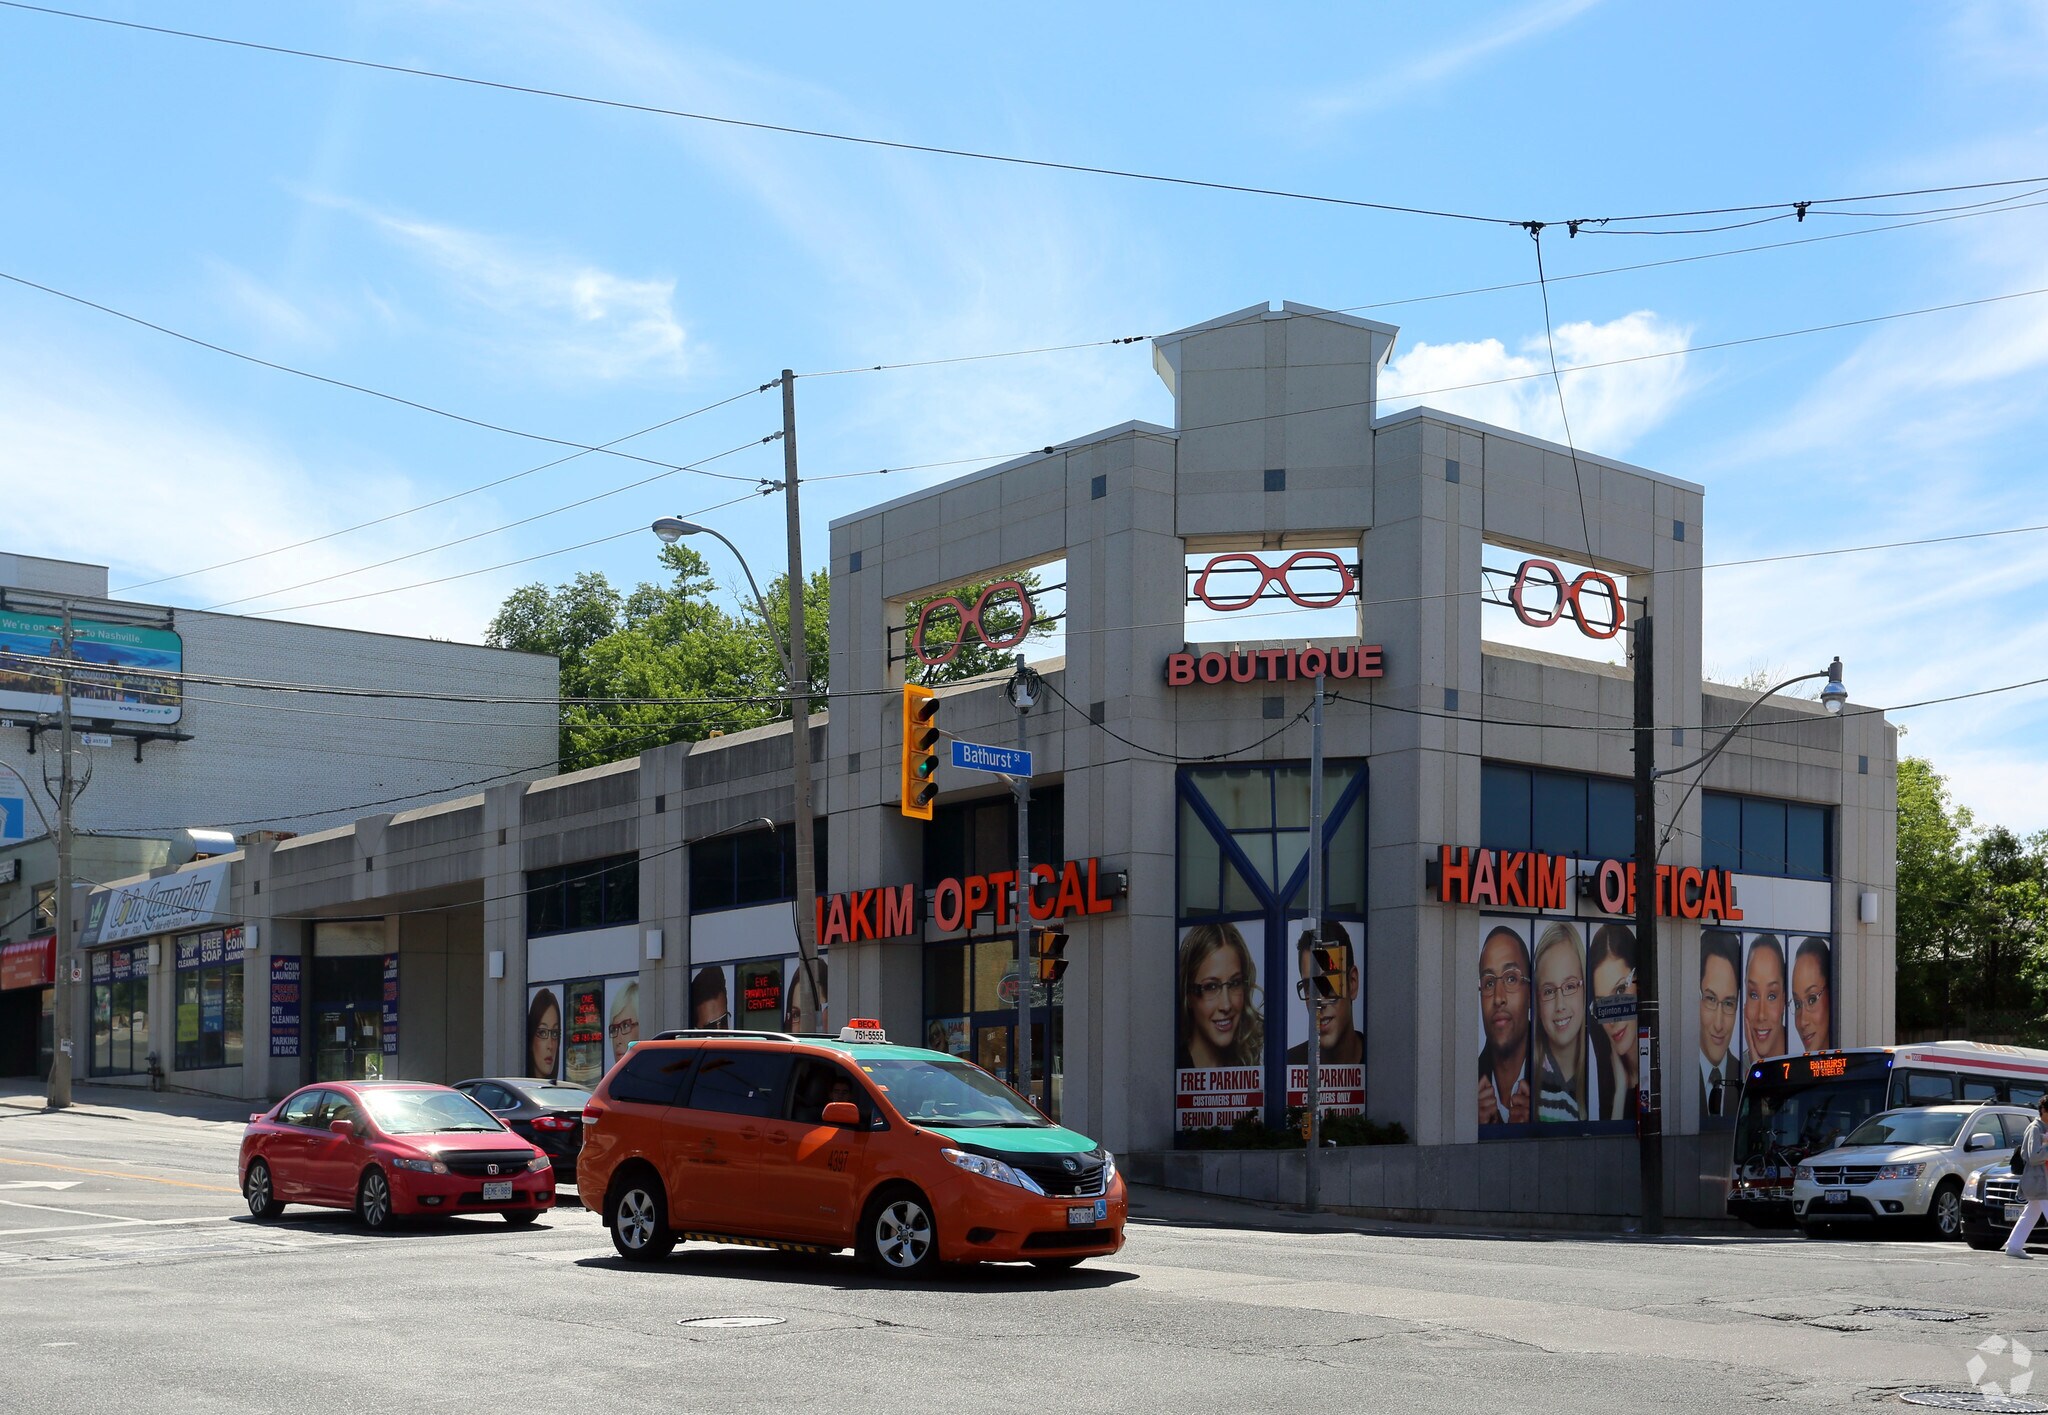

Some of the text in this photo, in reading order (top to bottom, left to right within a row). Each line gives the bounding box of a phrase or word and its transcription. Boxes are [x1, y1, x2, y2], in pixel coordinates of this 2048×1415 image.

[2, 618, 30, 631] We're
[33, 624, 45, 632] on
[87, 630, 95, 638] to
[98, 630, 143, 644] Nashville.
[1168, 644, 1384, 686] BOUTIQUE
[1, 719, 14, 727] 281
[963, 745, 1021, 769] Bathurst St
[1441, 844, 1567, 910] HAKIM
[933, 857, 1113, 932] OPTCAL
[110, 875, 211, 930] Coin Laundry
[202, 937, 221, 951] FREE
[182, 946, 194, 958] DRY
[201, 949, 222, 962] SOAP
[225, 950, 245, 961] LAUNDR
[178, 957, 199, 968] CLEANING
[284, 961, 299, 970] COIN
[272, 971, 300, 980] LAUNDRY
[755, 976, 769, 987] EYE
[748, 998, 776, 1009] CENTRE
[272, 1006, 283, 1014] DRY
[1598, 1007, 1621, 1017] Eglinton
[1631, 1003, 1637, 1012] W
[272, 1016, 299, 1024] CLEANING
[858, 1020, 877, 1028] BECK
[272, 1036, 298, 1045] PARKING
[855, 1030, 884, 1041] 751-5555
[273, 1046, 297, 1055] IN BACK
[1782, 1058, 1847, 1079] 7 BATHURST
[1813, 1068, 1844, 1077] TO STEELES
[1181, 1070, 1259, 1091] FREE PARKING
[1291, 1068, 1361, 1088] FRE PARKING
[1193, 1094, 1248, 1106] CUSTOMERS ONLY
[1337, 1091, 1351, 1103] ONLY
[1182, 1111, 1213, 1126] BEHIND
[827, 1150, 848, 1172] 4397
